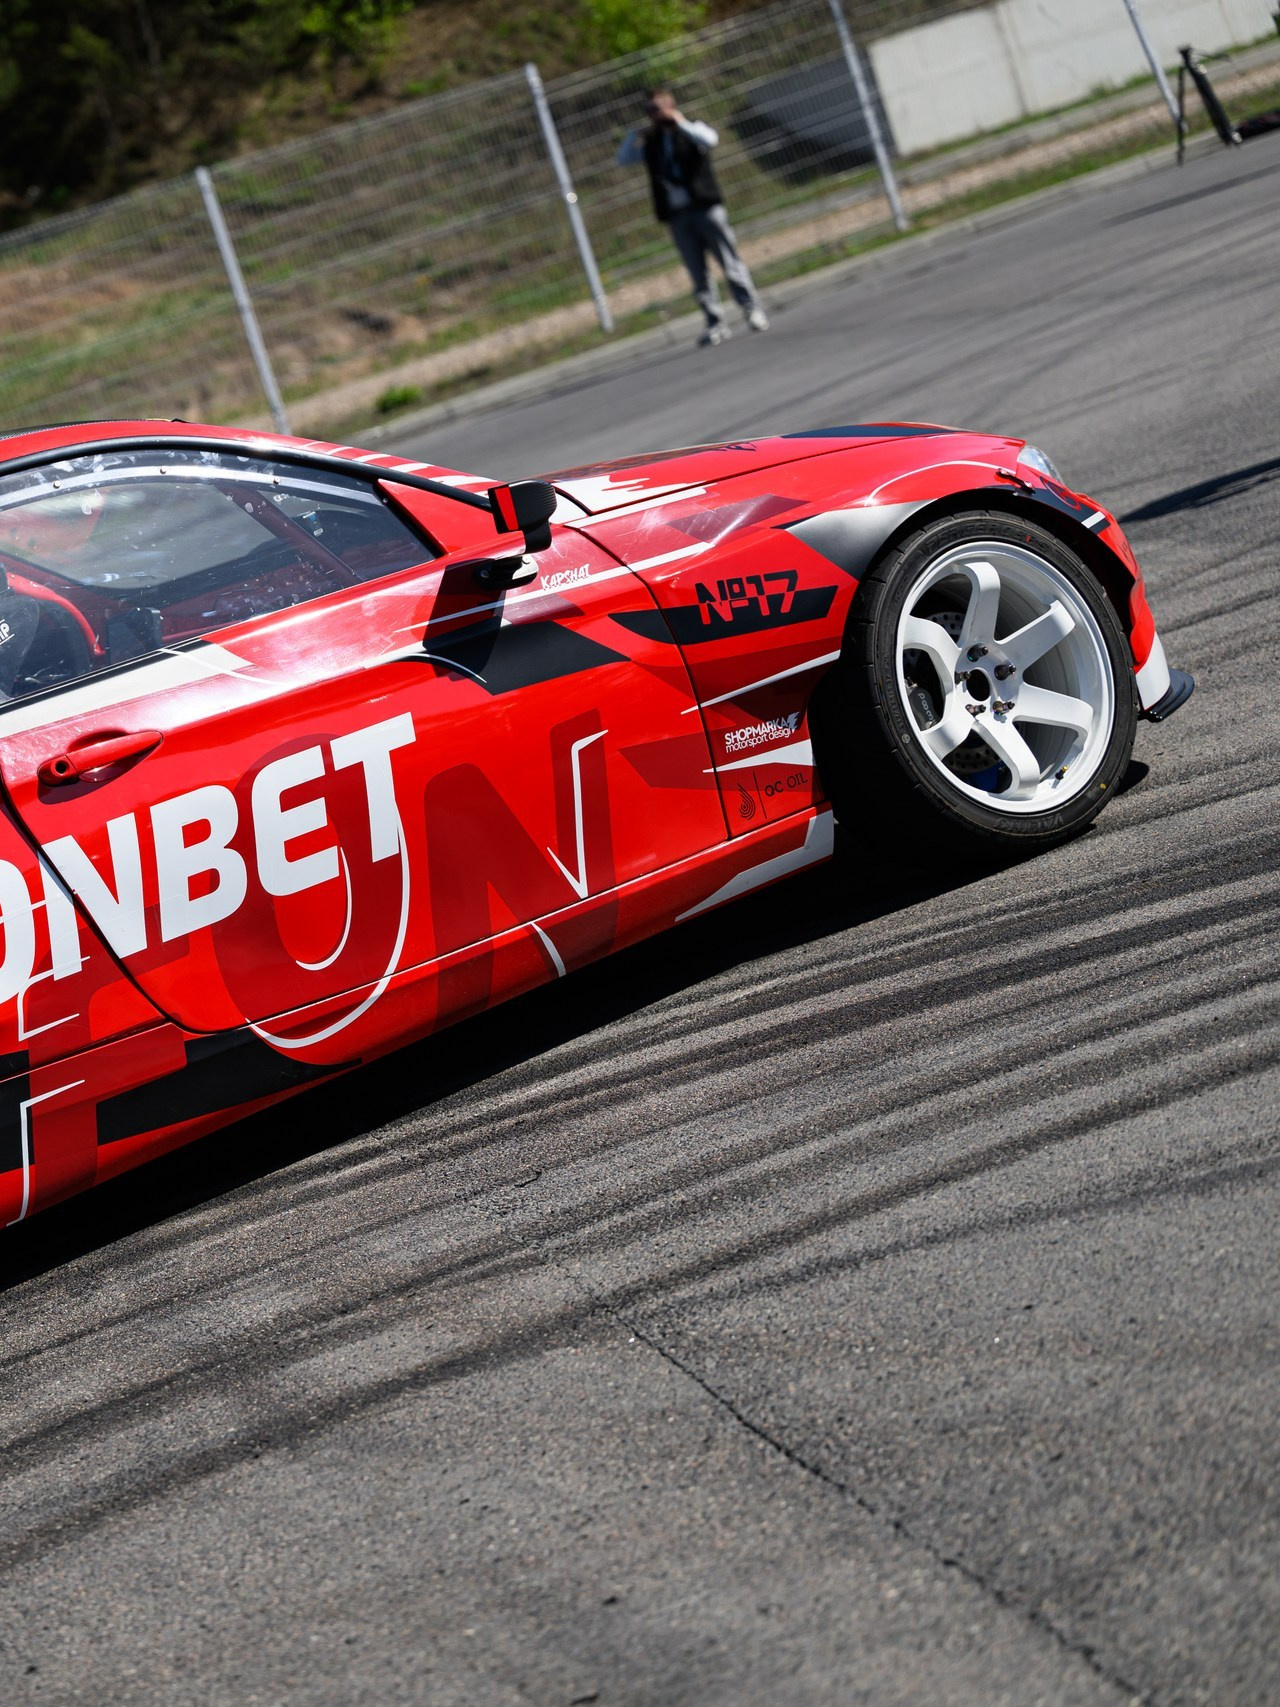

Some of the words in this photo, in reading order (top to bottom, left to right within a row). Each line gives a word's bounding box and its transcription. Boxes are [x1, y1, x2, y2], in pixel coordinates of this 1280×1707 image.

[724, 717, 788, 745] SHOPMARKA
[725, 735, 769, 753] motorsport
[764, 781, 784, 797] QC
[786, 772, 808, 788] OIL
